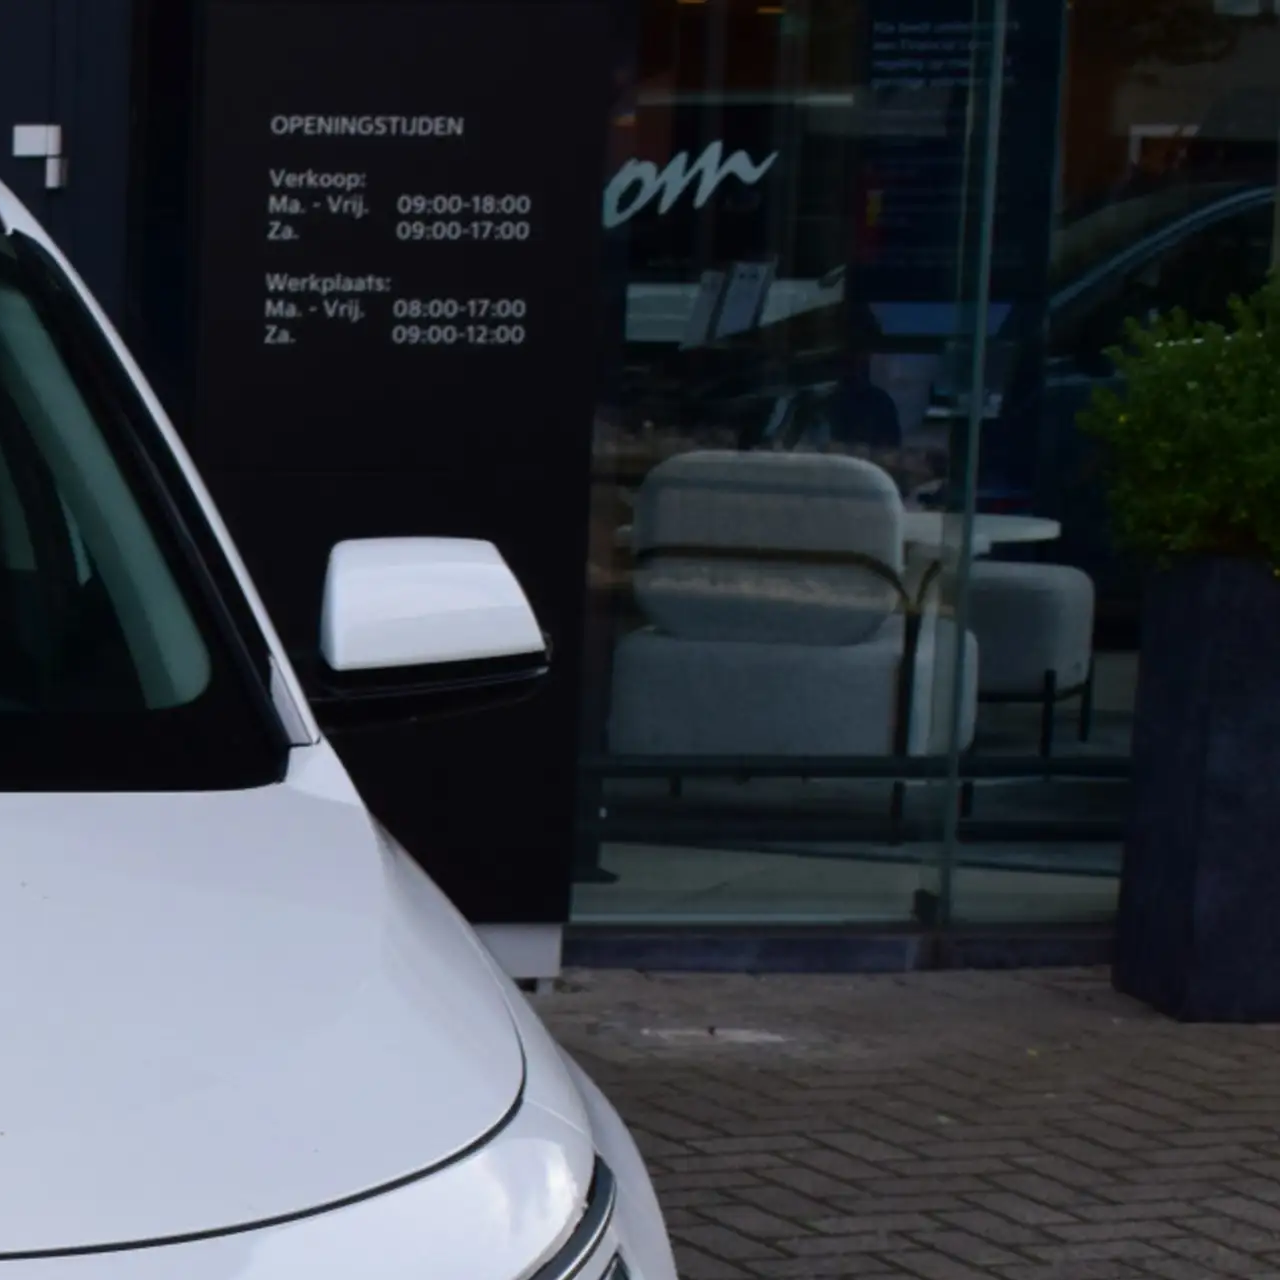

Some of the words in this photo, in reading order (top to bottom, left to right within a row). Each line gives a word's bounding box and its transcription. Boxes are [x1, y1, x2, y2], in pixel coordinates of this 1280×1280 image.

[270, 115, 464, 136] OPENINGSTIJDEN
[269, 168, 366, 191] Verkoop:
[268, 195, 306, 214] Ma.
[326, 195, 369, 219] Vrij.
[396, 195, 531, 214] 09:00-18:00
[267, 221, 299, 240] Za.
[396, 221, 530, 240] 09:00-17:00
[265, 273, 391, 295] Werkplaats:
[265, 299, 302, 317] Ma.
[323, 299, 365, 322] Vrij.
[392, 299, 526, 318] 08:00-17:00
[264, 325, 296, 344] Za.
[392, 325, 525, 344] 09:00-12:00
